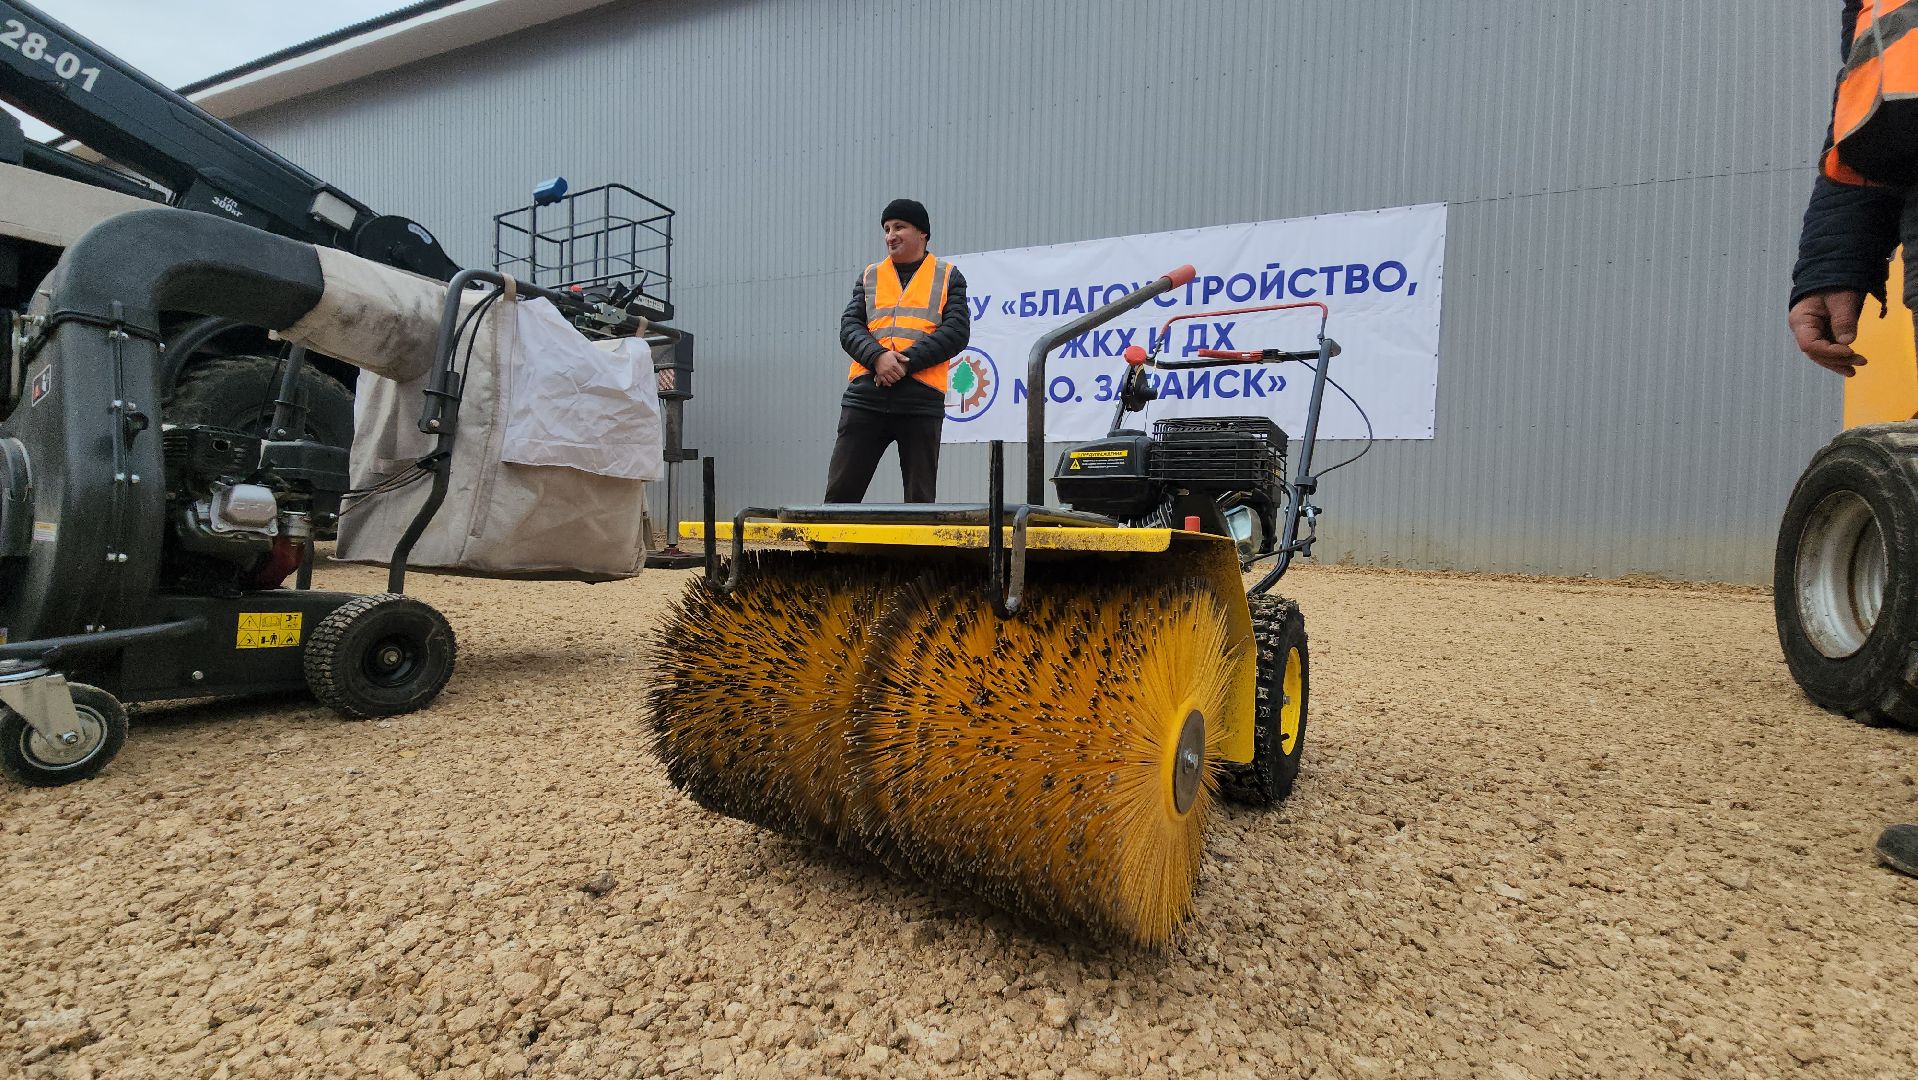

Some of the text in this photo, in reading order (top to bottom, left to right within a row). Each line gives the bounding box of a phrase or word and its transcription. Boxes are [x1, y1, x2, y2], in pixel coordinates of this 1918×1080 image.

[0, 19, 101, 93] 28-01
[966, 260, 1418, 321] У «БЛАГОСТРОЙСТВО,
[1058, 321, 1236, 359] ЖКХ И ДХ
